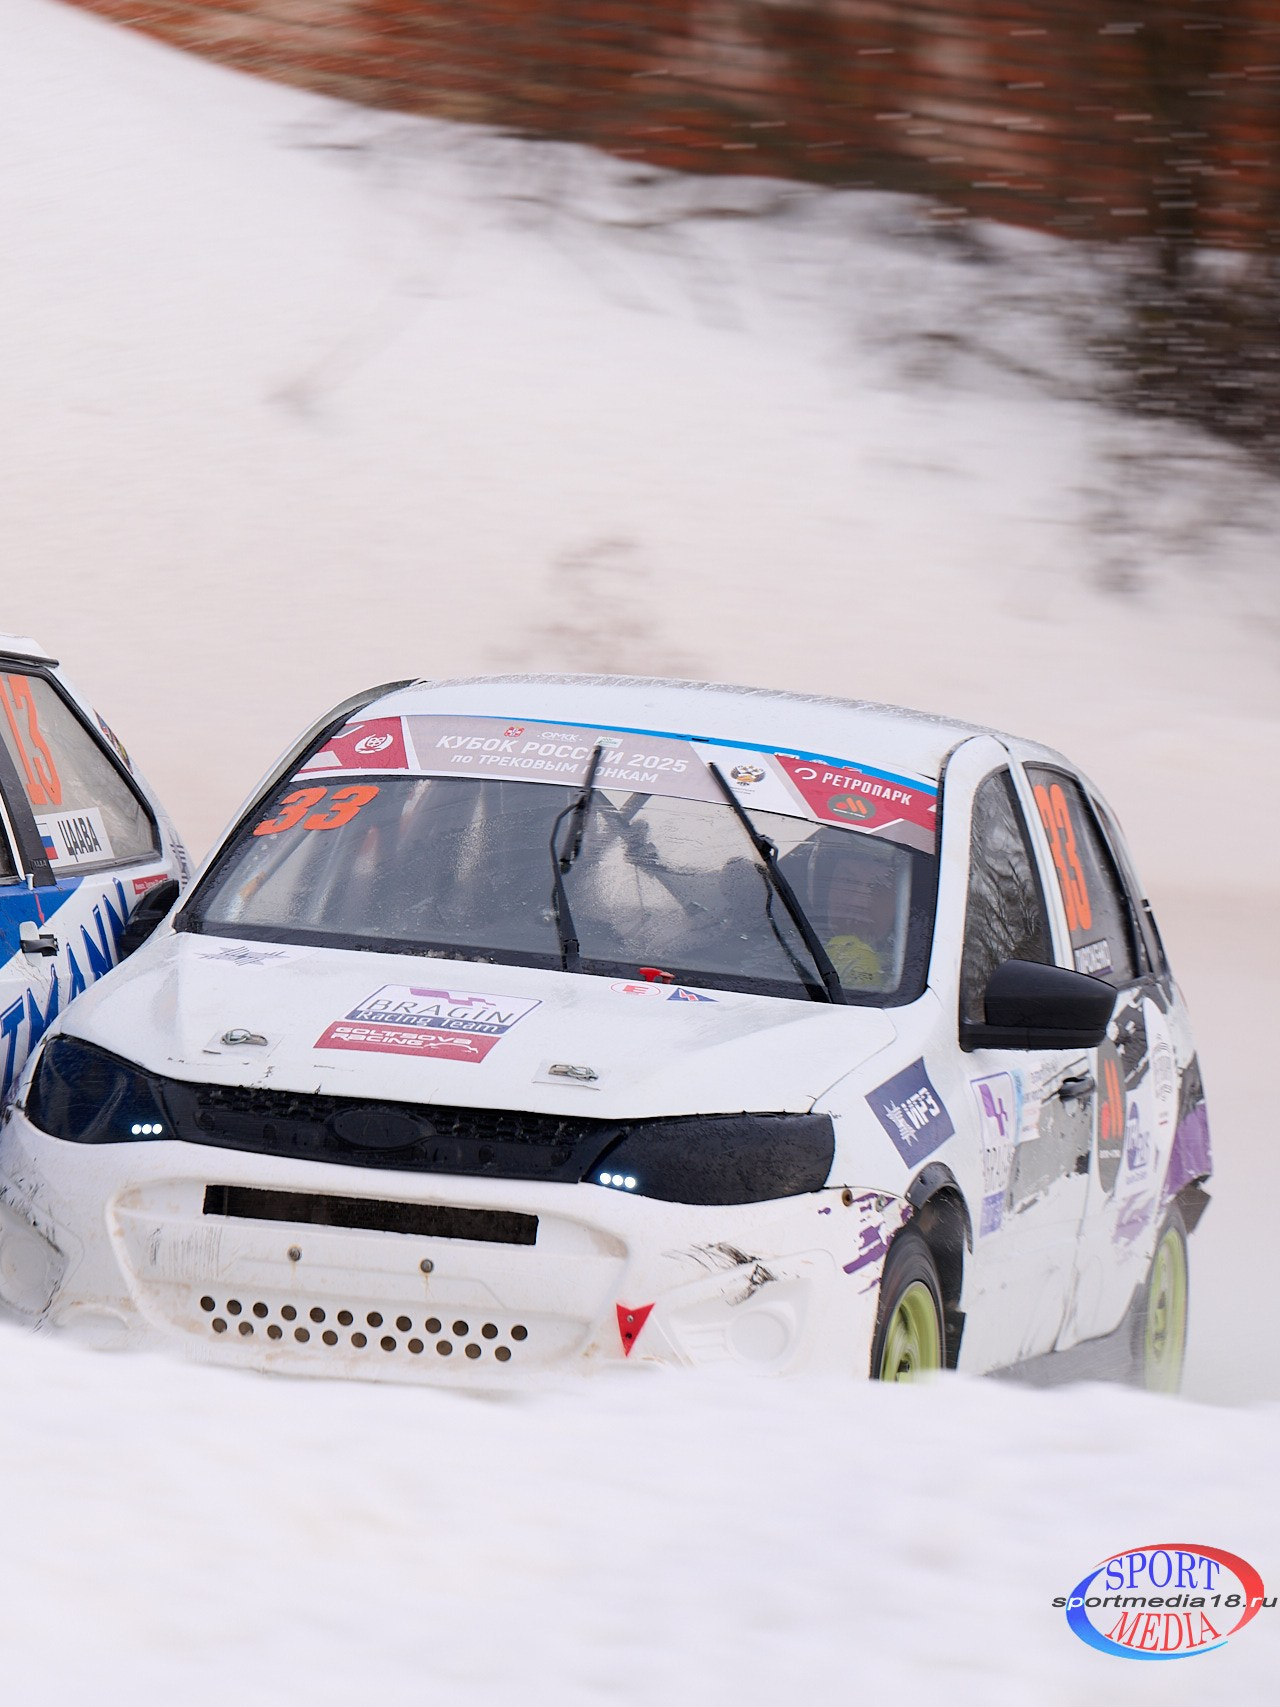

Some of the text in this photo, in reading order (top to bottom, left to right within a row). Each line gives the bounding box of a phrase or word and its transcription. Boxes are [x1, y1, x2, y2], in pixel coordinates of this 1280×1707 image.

[435, 736, 518, 753] КУБОК
[626, 753, 689, 773] 2025
[451, 754, 473, 764] по
[478, 754, 579, 774] ТРЕКОВЫМ
[822, 772, 913, 806] РЕТРОПАРК
[253, 785, 380, 836] 33
[57, 816, 102, 862] ЦААВА
[1034, 784, 1092, 931] 33
[355, 1010, 500, 1033] Racing Team
